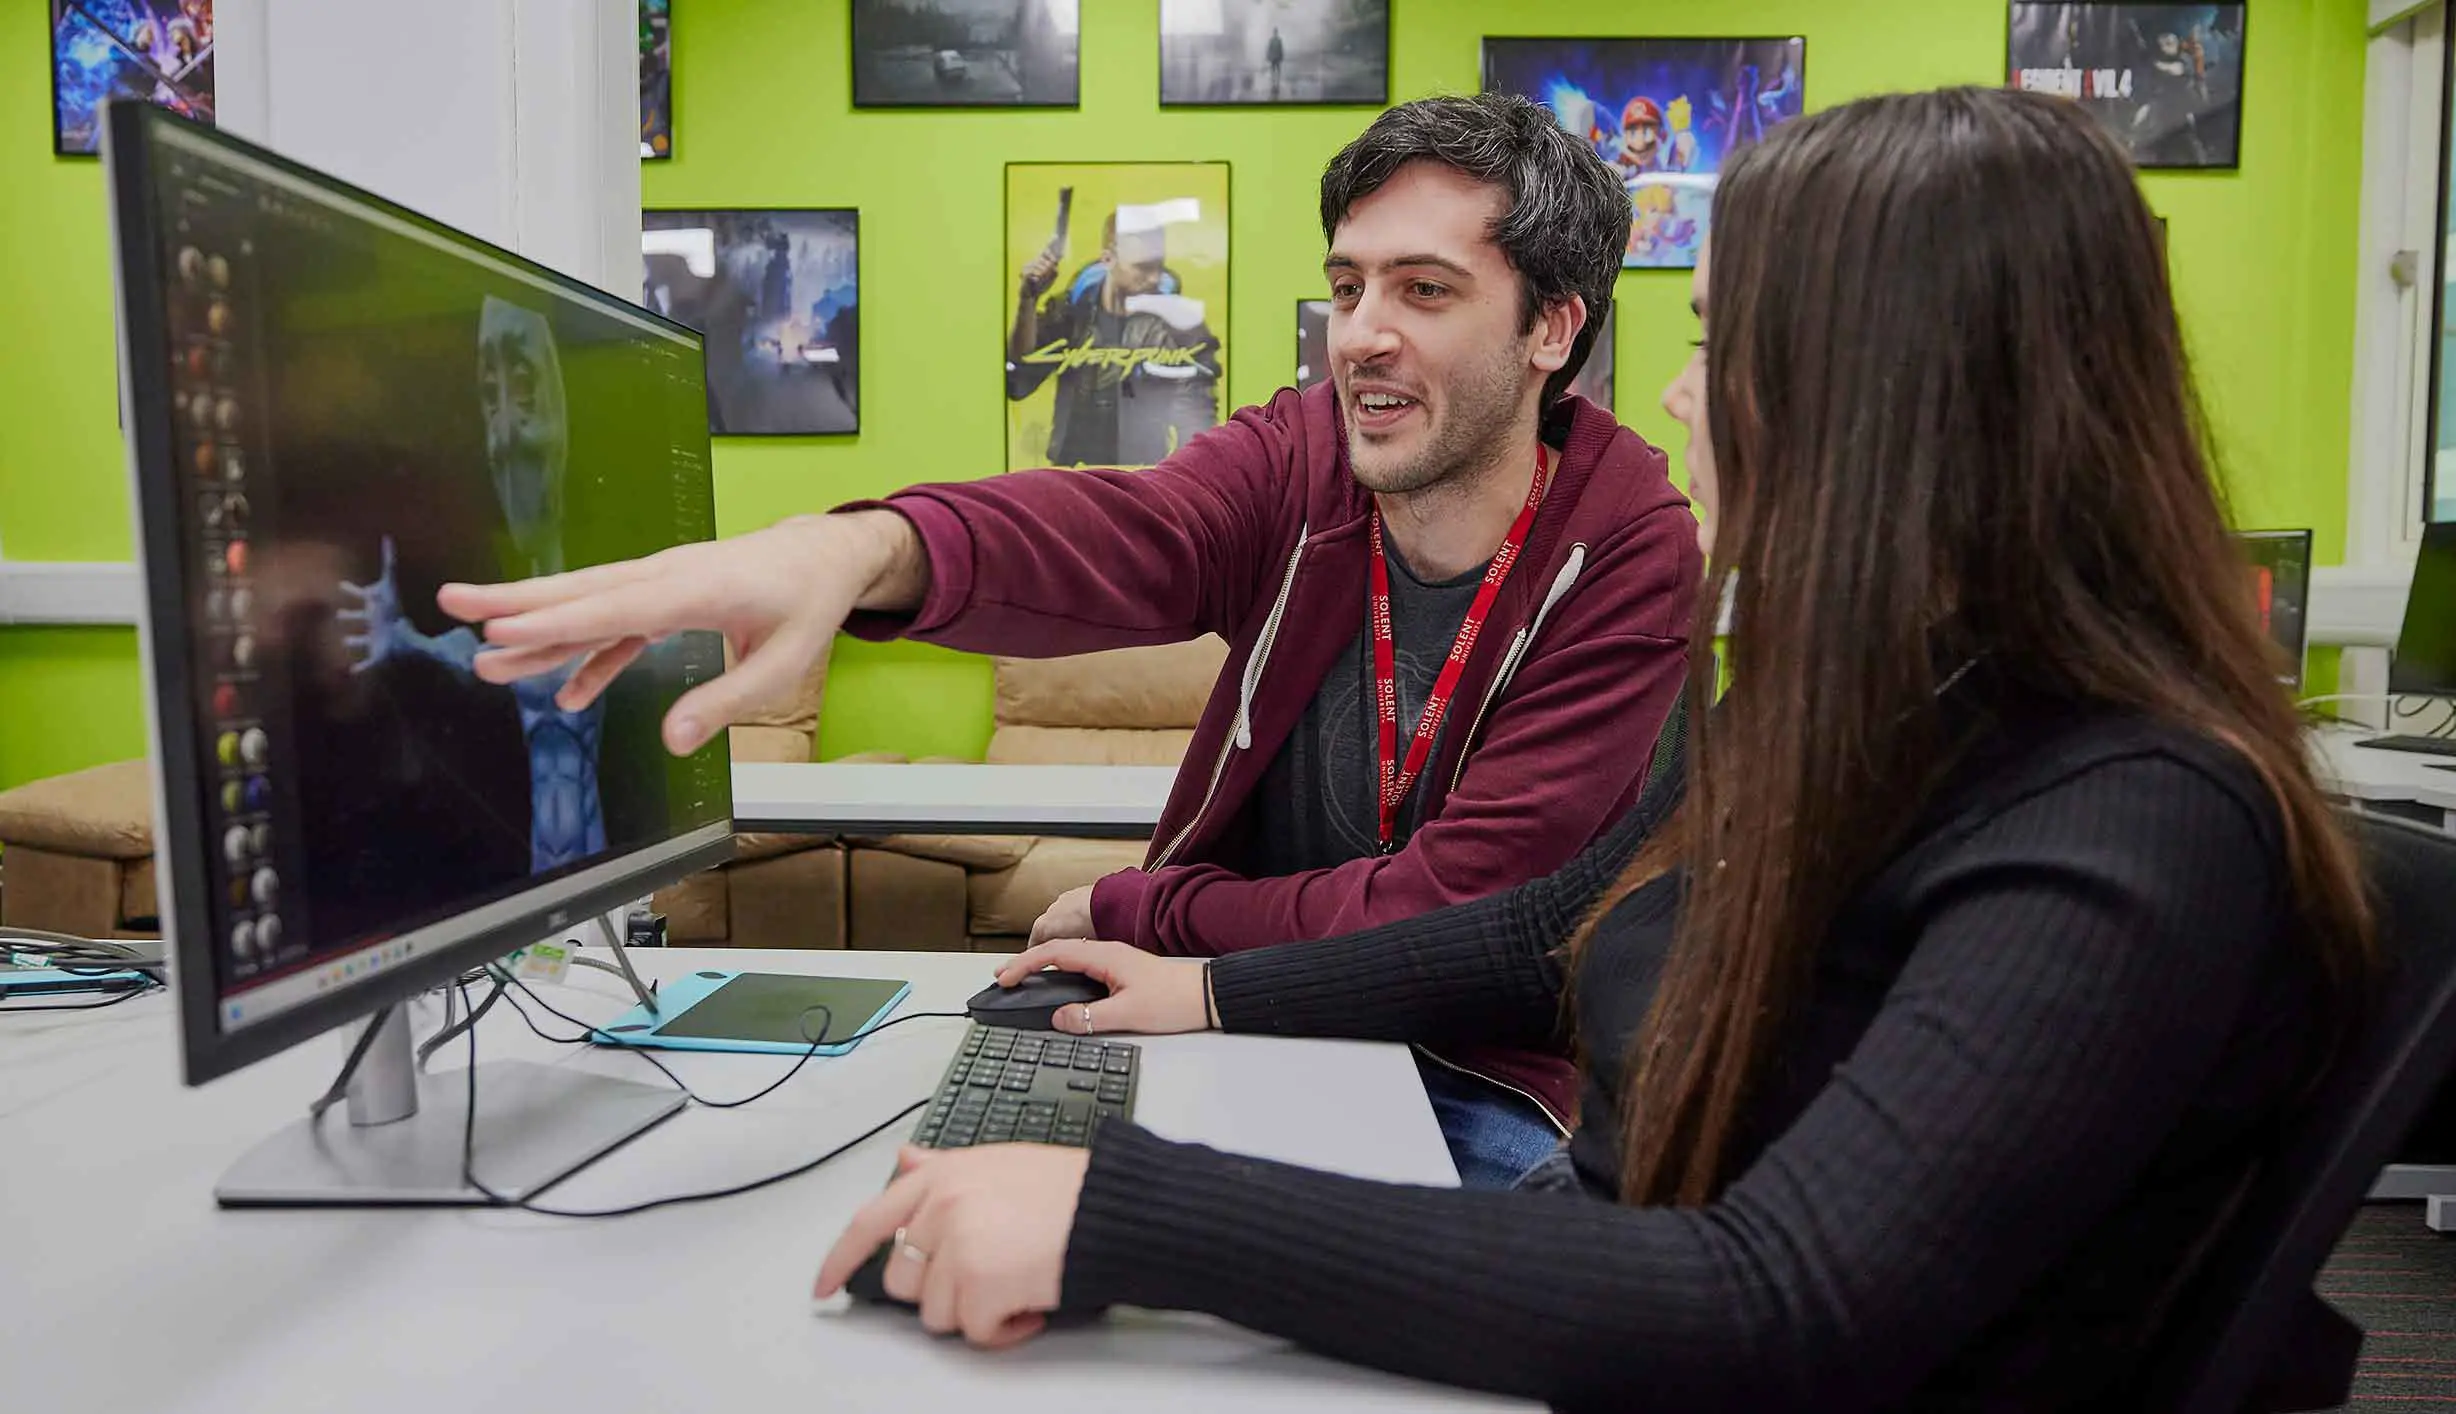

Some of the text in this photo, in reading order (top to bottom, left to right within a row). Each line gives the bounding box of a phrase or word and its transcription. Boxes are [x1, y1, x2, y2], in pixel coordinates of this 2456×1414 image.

[2119, 68, 2133, 98] 4
[1485, 539, 1513, 584] SOLENT
[1379, 594, 1392, 641] SOLENT
[1449, 616, 1475, 662] SOLENT
[1383, 678, 1396, 723] SOLENT
[1417, 694, 1441, 738] SOLENT
